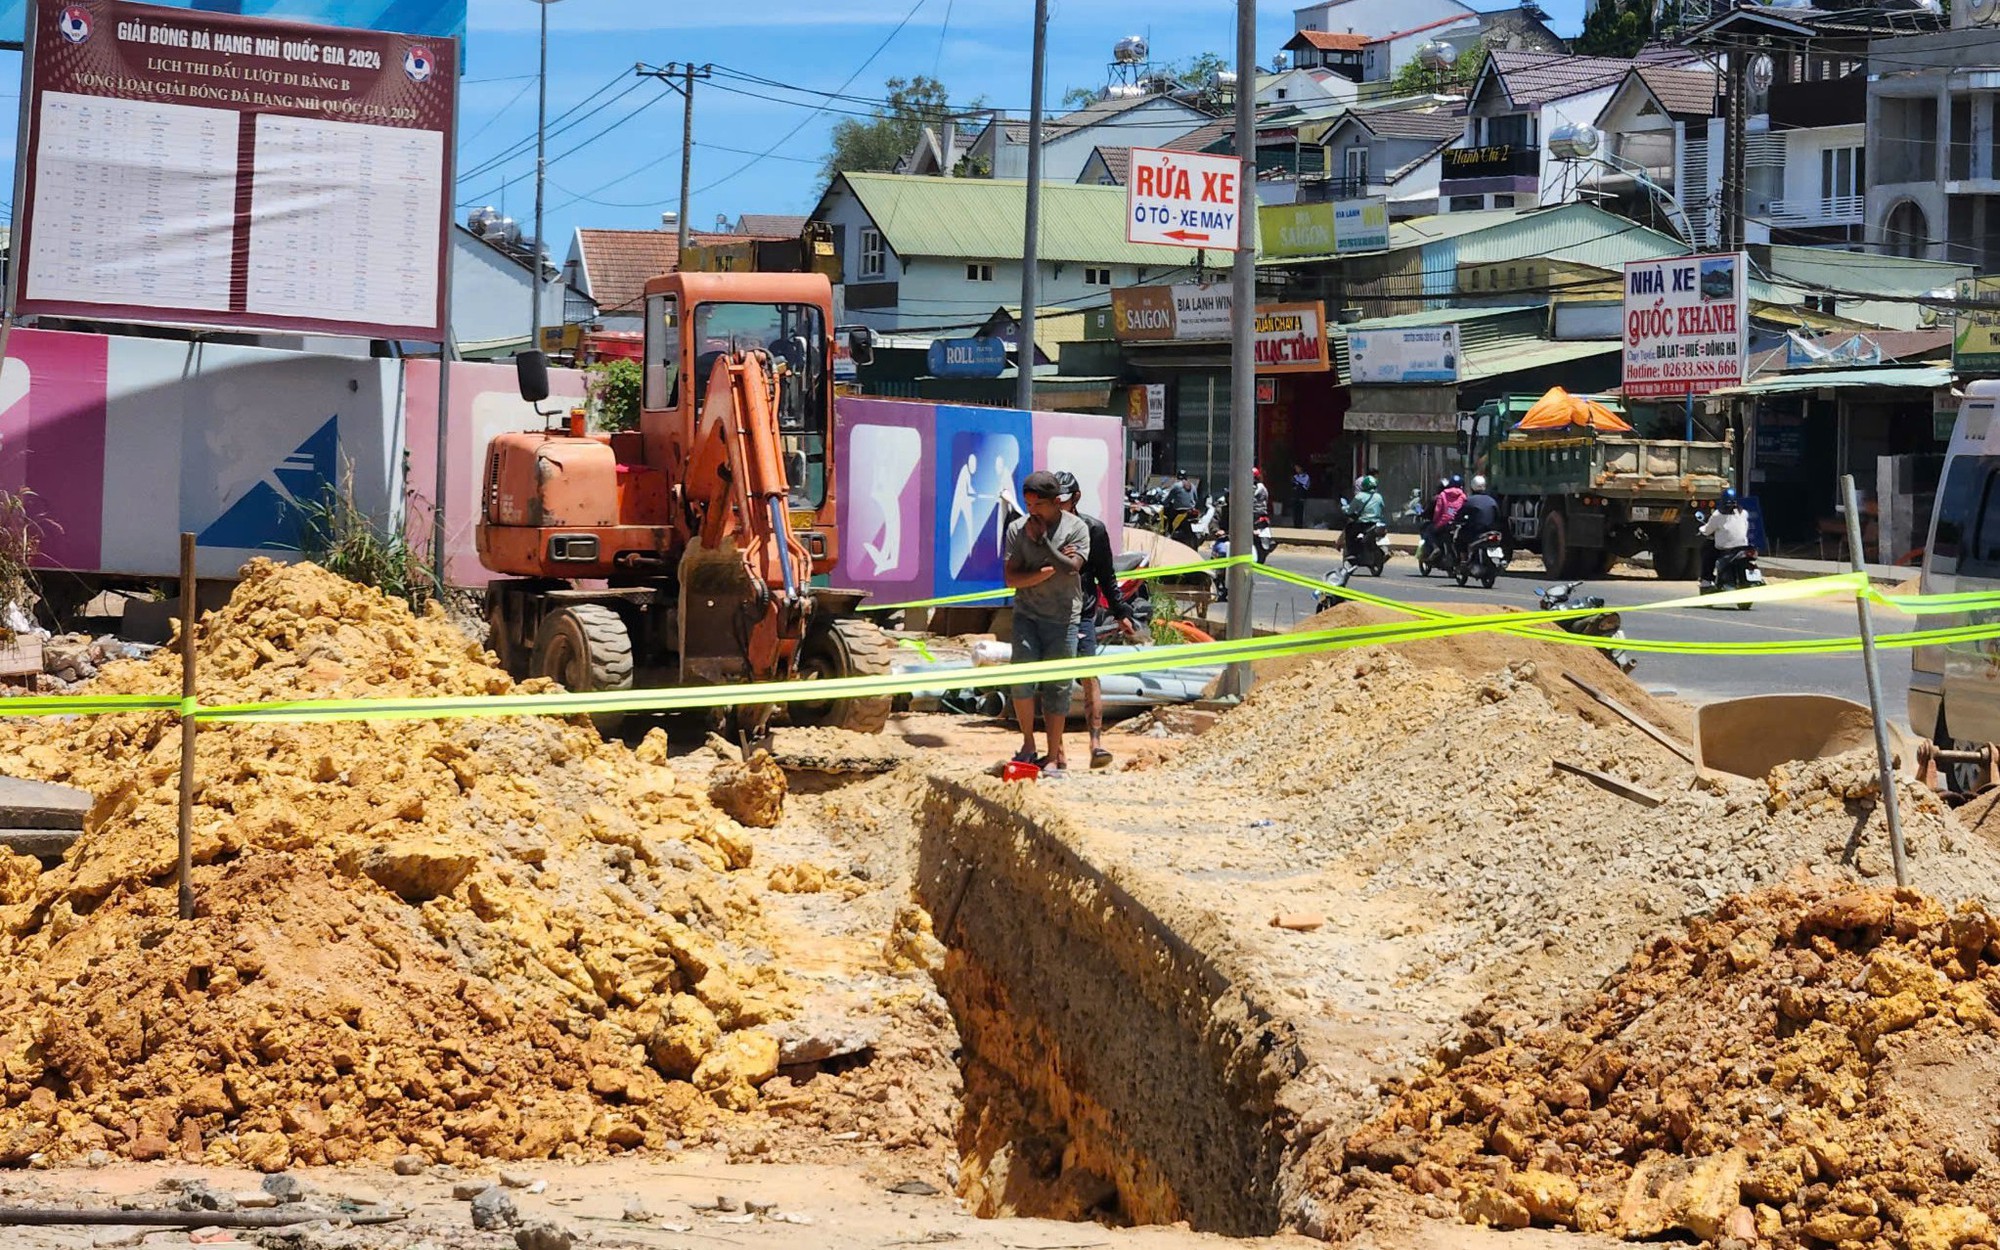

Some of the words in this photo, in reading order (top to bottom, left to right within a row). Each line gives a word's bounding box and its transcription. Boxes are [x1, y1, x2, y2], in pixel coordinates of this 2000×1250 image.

[117, 18, 146, 43] GIẢI
[149, 24, 188, 48] BÓNG
[190, 28, 211, 50] ĐÁ
[213, 33, 252, 56] HẠNG
[255, 35, 280, 58] NHÌ
[282, 38, 320, 62] QUỐC
[322, 45, 346, 66] GIA
[348, 48, 381, 70] 2024
[147, 57, 181, 74] LỊCH
[184, 61, 209, 76] THI
[211, 61, 241, 79] ĐẤU
[244, 67, 281, 85] LƯỢT
[283, 72, 299, 86] ĐI
[301, 72, 338, 90] BẢNG
[341, 79, 351, 91] B
[73, 72, 114, 88] VÒNG
[118, 78, 153, 95] LOẠI
[155, 80, 186, 96] GIẢI
[189, 84, 229, 100] BÓNG
[231, 87, 250, 103] ĐÁ
[254, 92, 293, 108] HẠNG
[295, 95, 320, 111] NHÌ
[323, 96, 361, 113] QUỐC
[364, 104, 387, 117] GIA
[390, 107, 417, 120] 2024
[1452, 148, 1480, 167] Hạnh
[1501, 144, 1510, 161] 2
[1136, 156, 1191, 201] RỬA
[1201, 171, 1234, 204] XE
[1135, 203, 1146, 222] Ô
[1149, 204, 1170, 224] TÔ
[1180, 209, 1198, 227] XE
[1201, 209, 1234, 230] MÁY
[1631, 264, 1664, 295] NHÀ
[1672, 267, 1696, 292] XE
[1127, 309, 1170, 329] SAIGON
[1178, 298, 1191, 311] BIA
[1192, 297, 1215, 315] LẠNH
[1215, 296, 1232, 310] WIN
[1628, 297, 1673, 347] QUỐC
[946, 347, 975, 364] ROLL
[1288, 332, 1320, 361] TÂM
[1656, 342, 1666, 359] ĐÀ
[1667, 345, 1680, 361] LẠT
[1685, 339, 1699, 358] HUẾ
[1705, 339, 1725, 356] ĐÔNG
[1726, 339, 1737, 355] HÀ
[1626, 364, 1660, 379] Hotline:
[1663, 360, 1737, 377] 02633.888.666
[1150, 398, 1162, 410] WIN
